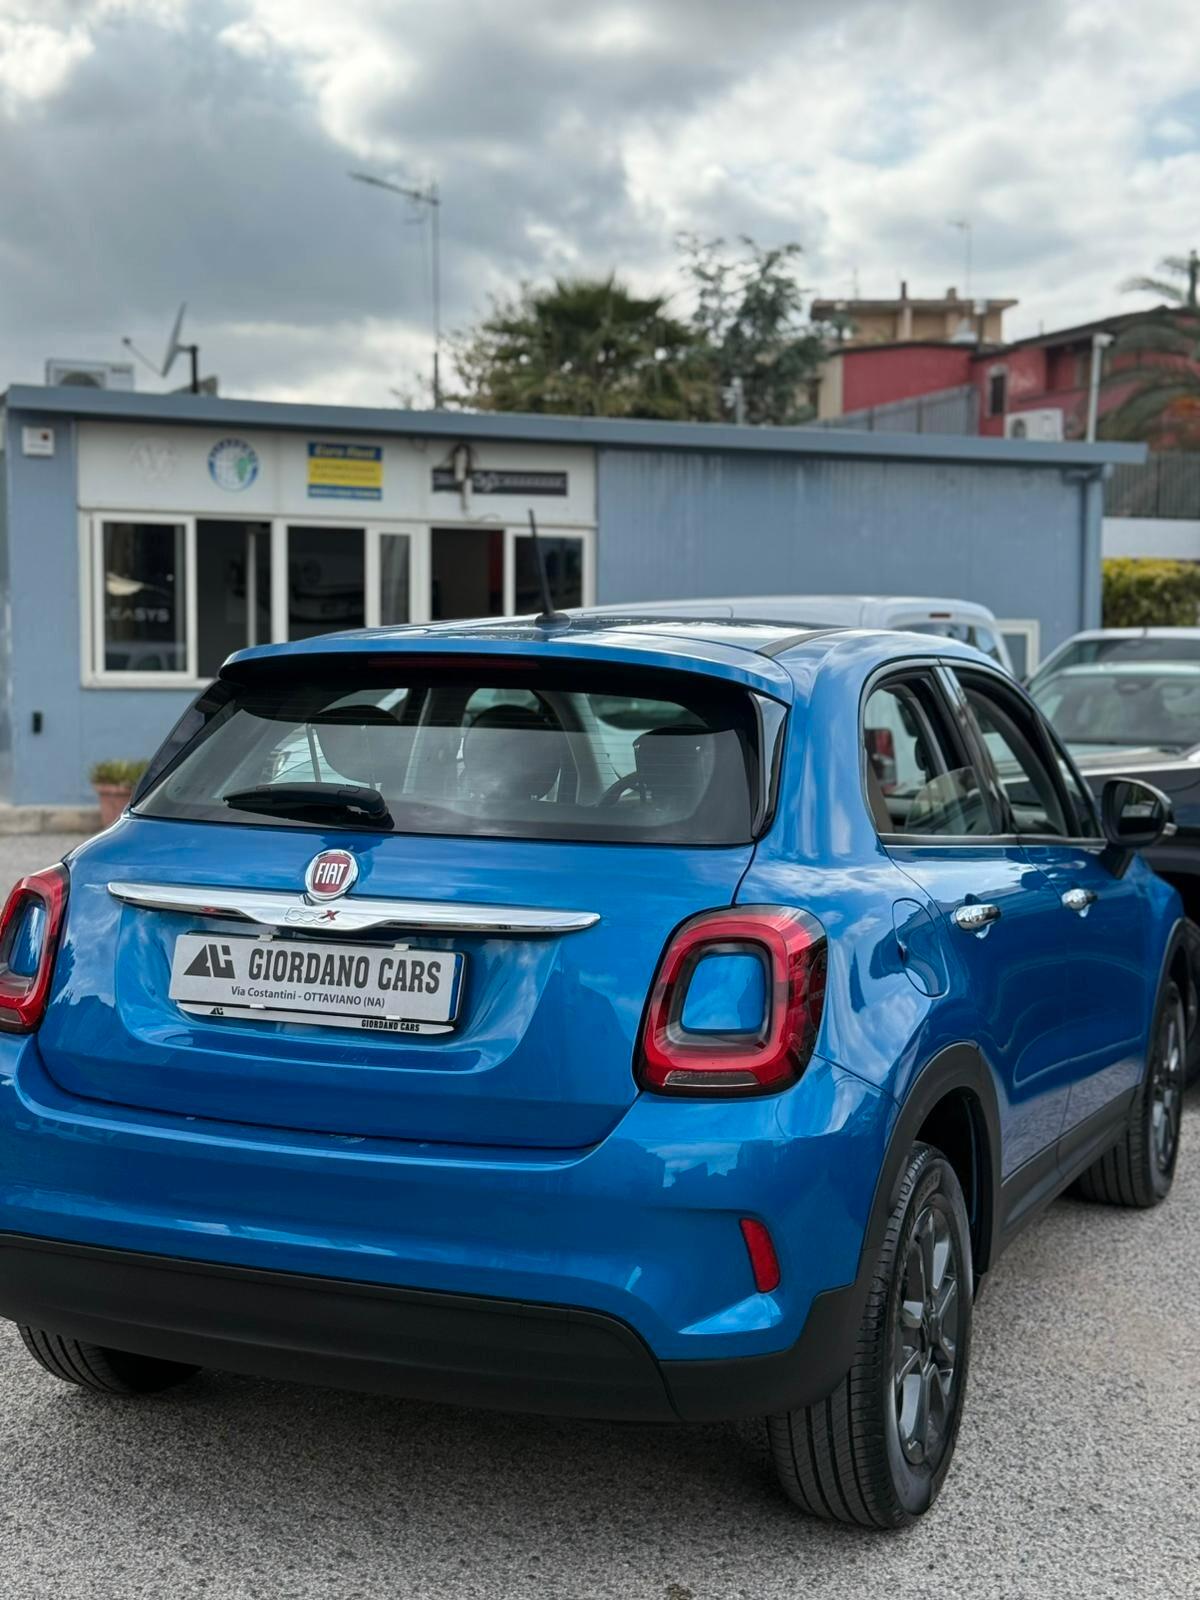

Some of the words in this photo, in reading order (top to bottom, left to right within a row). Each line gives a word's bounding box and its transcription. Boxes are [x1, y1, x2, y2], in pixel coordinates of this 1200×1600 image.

[314, 862, 348, 885] FIAT
[248, 948, 370, 989] GIORDANO
[377, 957, 442, 994] CARS
[231, 986, 246, 996] Via
[247, 987, 297, 1001] Costantini
[303, 991, 362, 1006] OTTAVIANO
[363, 996, 385, 1009] (NA)
[361, 1018, 399, 1031] GIORDANO
[400, 1023, 420, 1032] CARS
